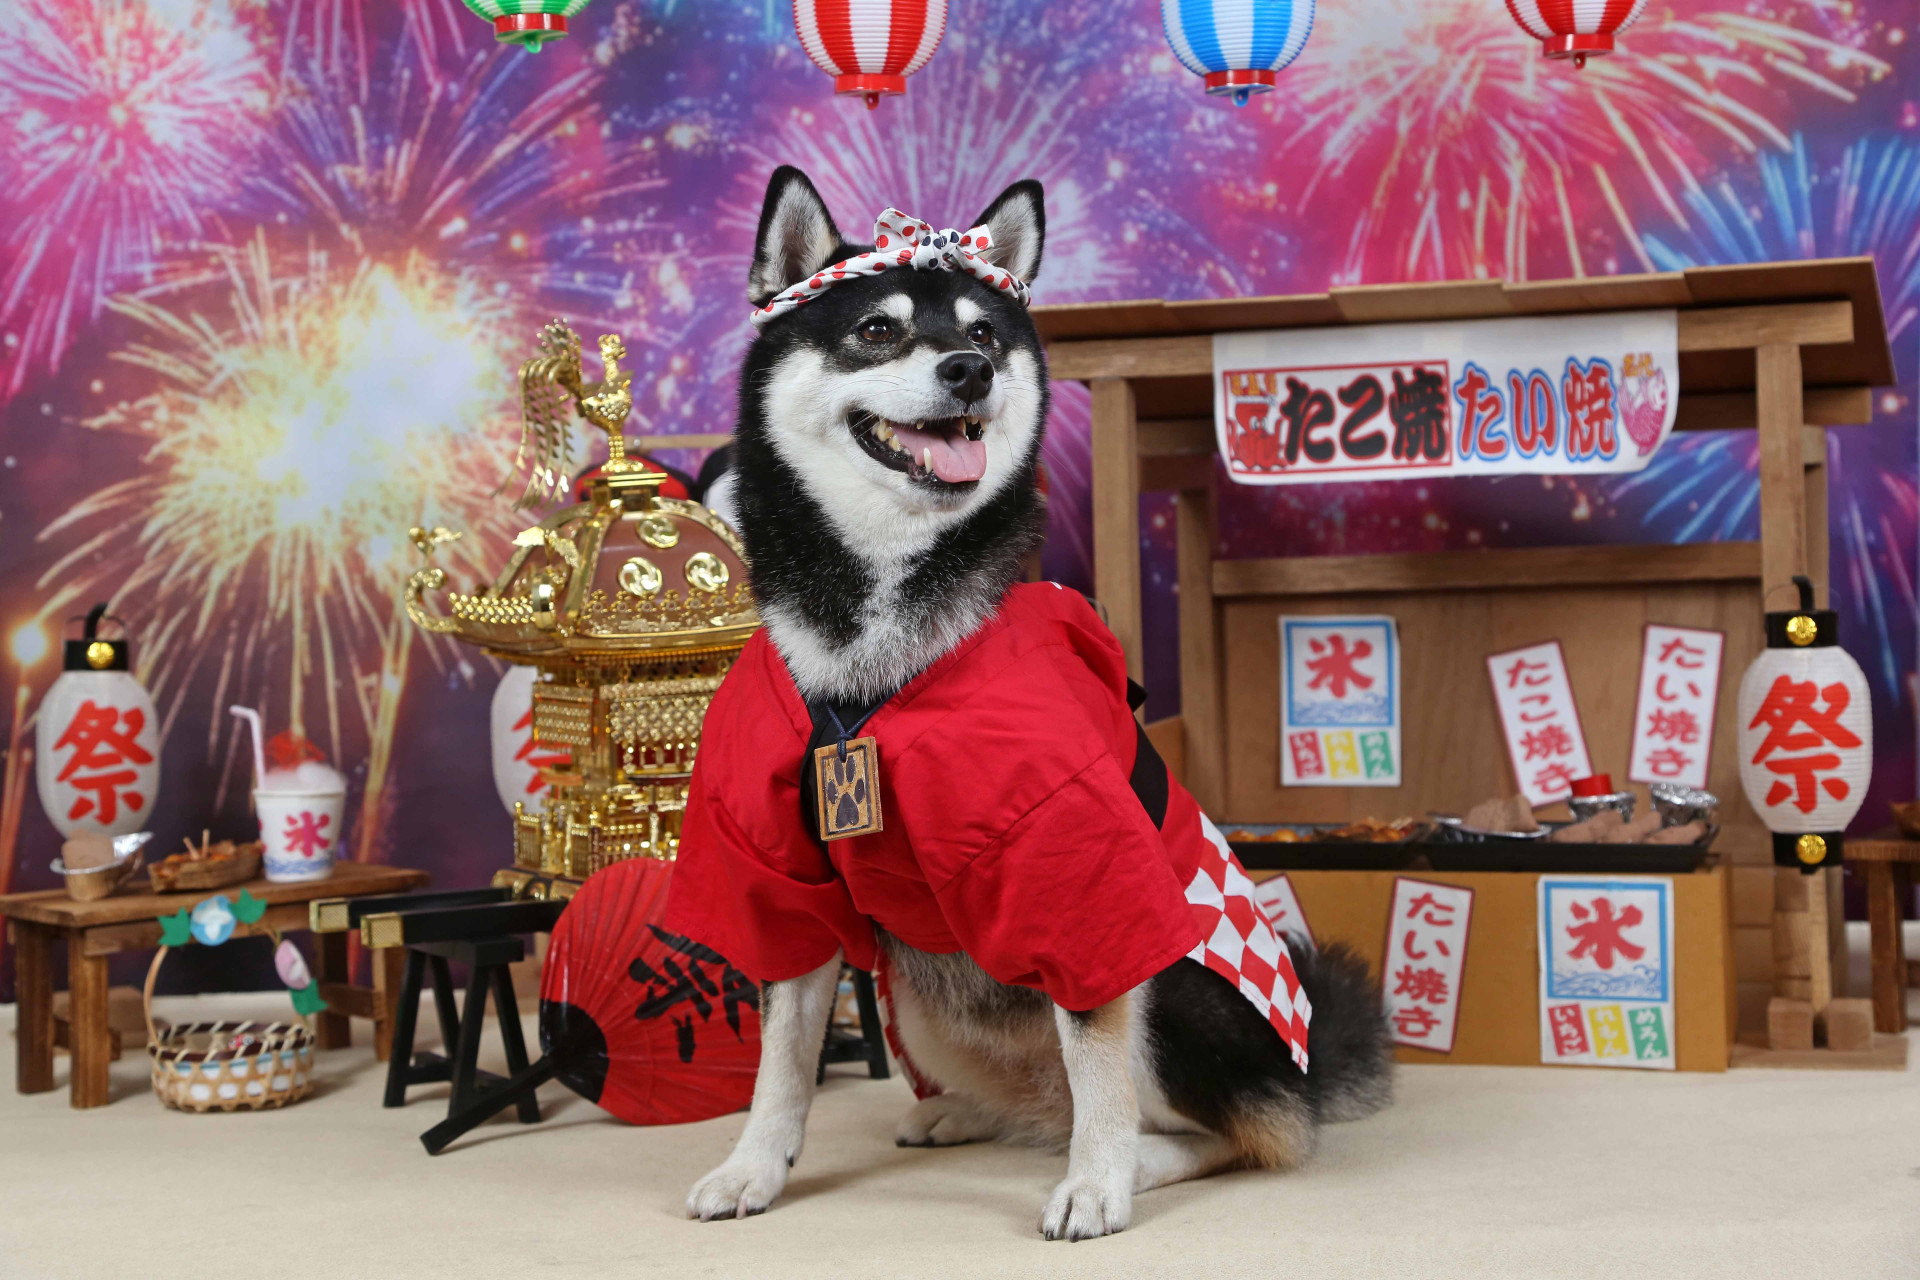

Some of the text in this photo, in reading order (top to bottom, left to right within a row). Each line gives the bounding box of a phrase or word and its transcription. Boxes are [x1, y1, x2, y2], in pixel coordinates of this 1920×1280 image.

[1279, 367, 1448, 464] たこ焼
[1454, 357, 1619, 463] たい焼
[1305, 633, 1376, 698] 氷
[1645, 638, 1705, 777] たい焼き
[53, 700, 154, 826] 祭
[1506, 659, 1577, 794] たこ焼き
[1748, 674, 1863, 815] 祭
[283, 811, 331, 857] 氷
[1392, 892, 1456, 1038] たい焼き
[1565, 897, 1646, 970] 氷
[1554, 1007, 1583, 1055] いちご
[1594, 1008, 1623, 1057] れもん
[1635, 1010, 1663, 1059] めろん
